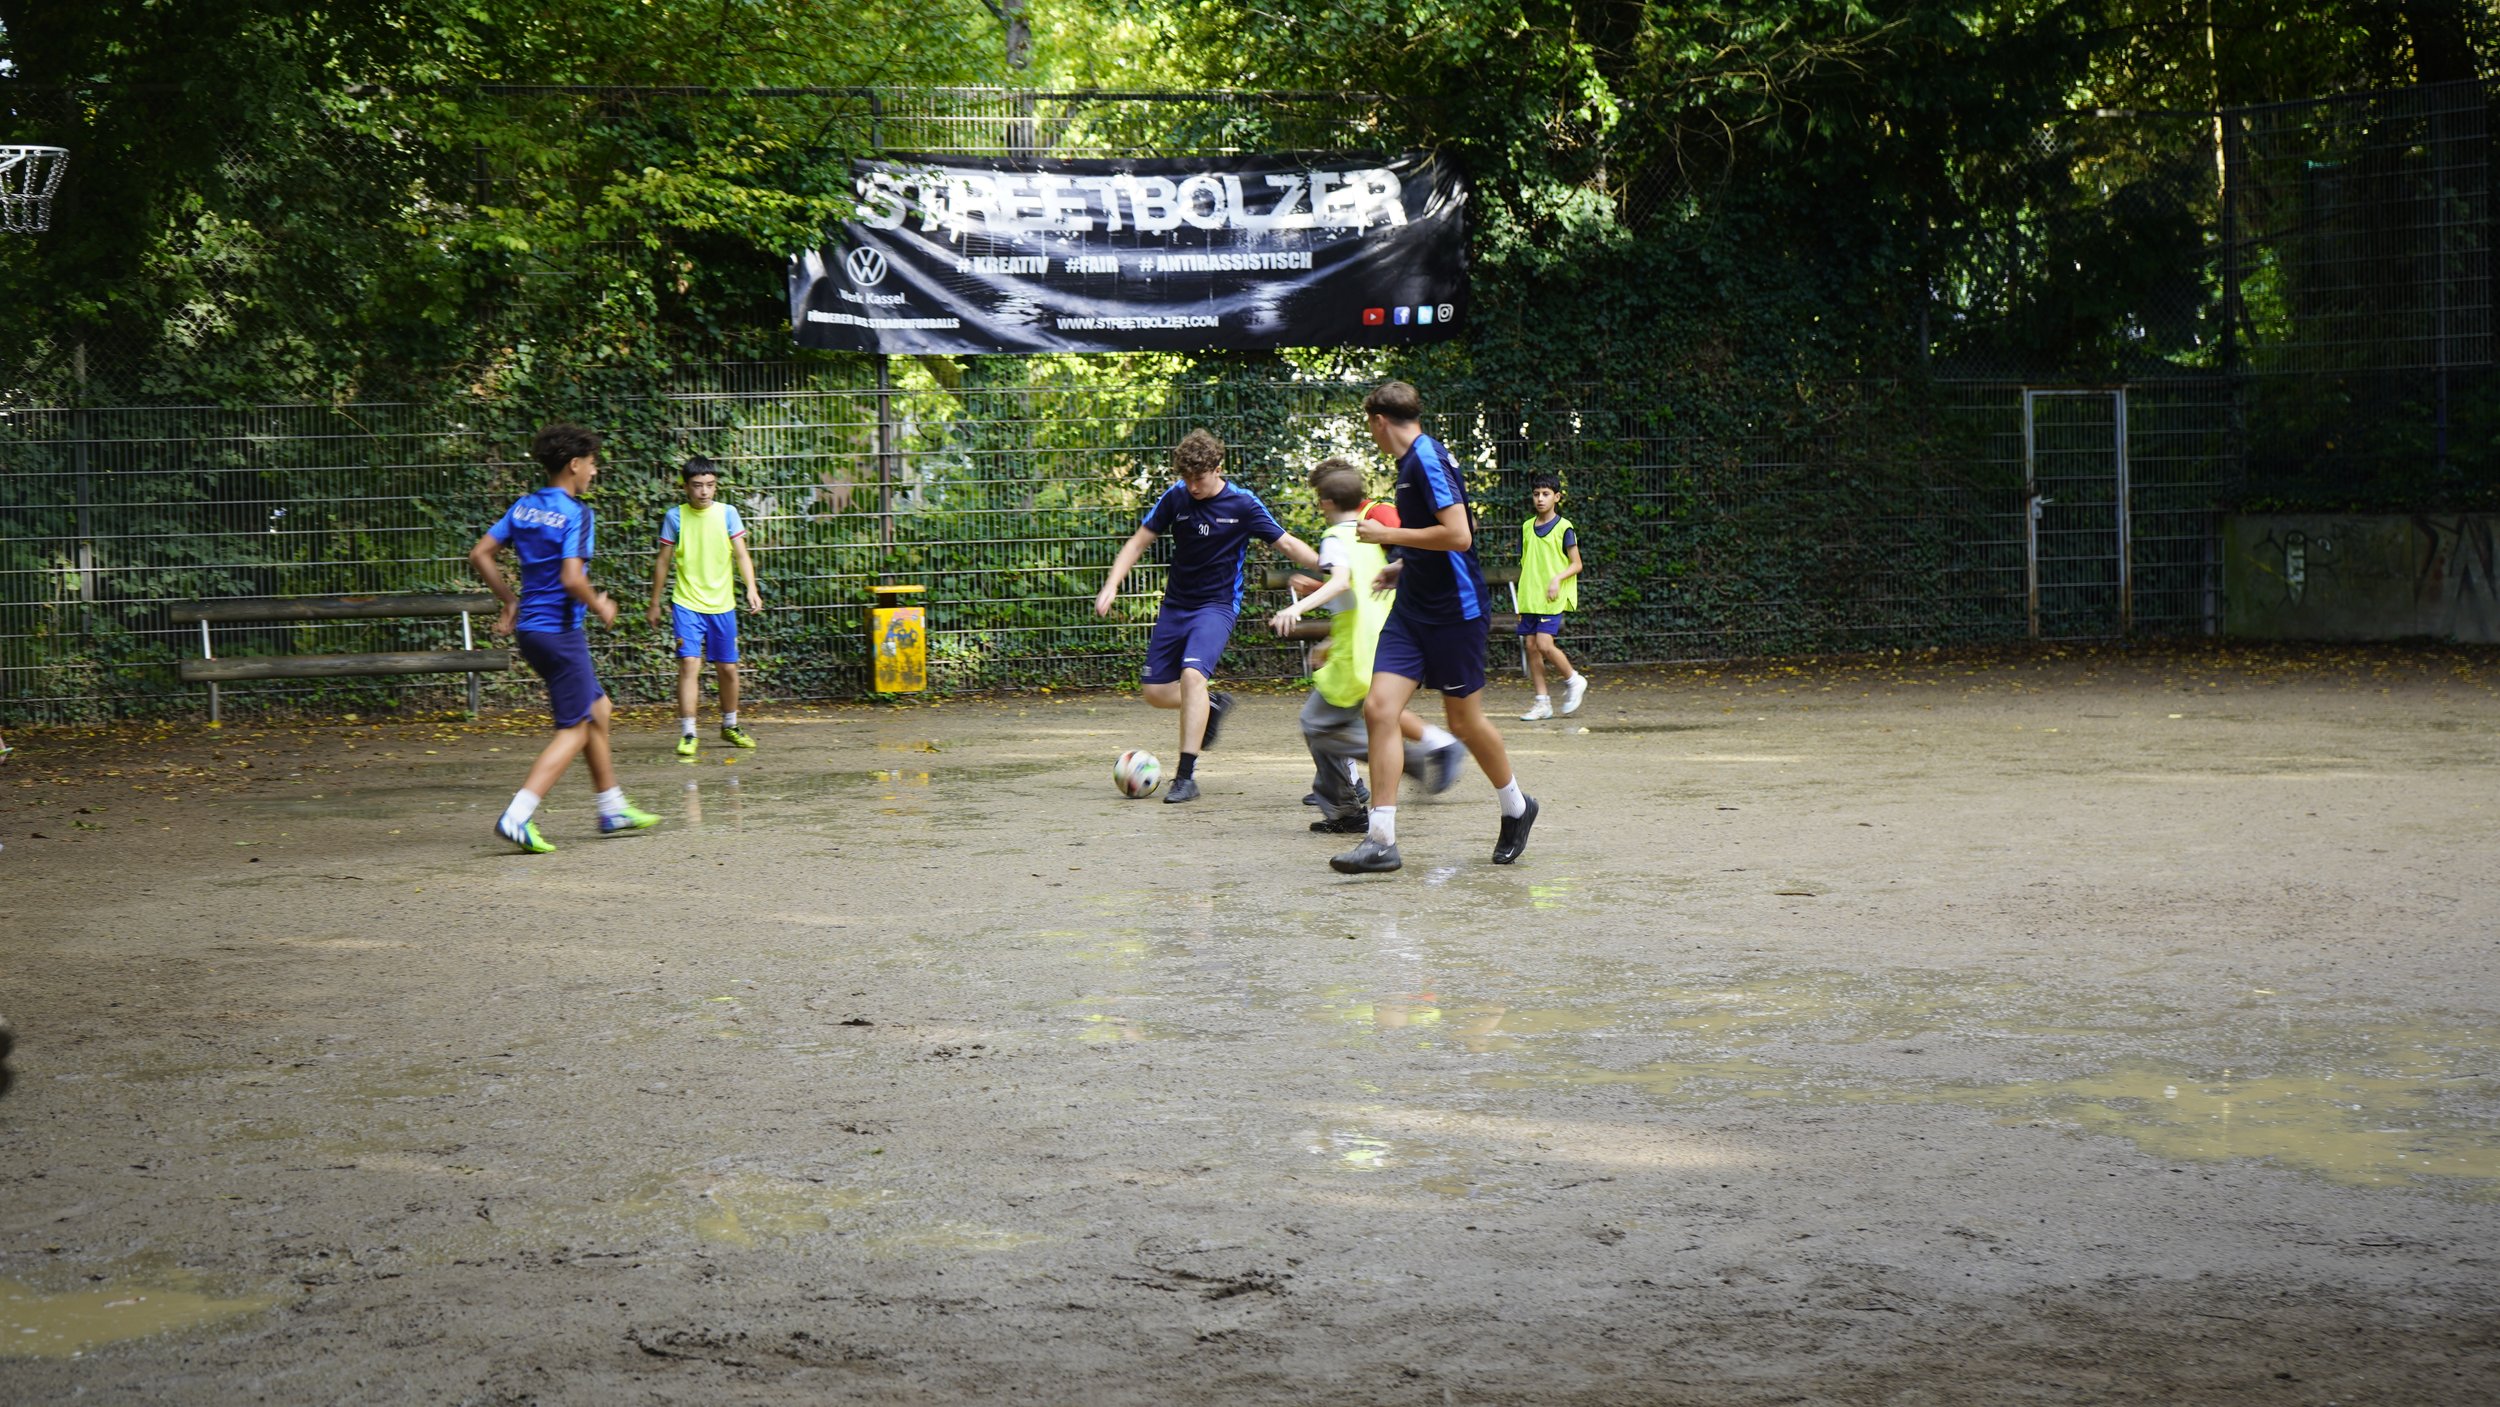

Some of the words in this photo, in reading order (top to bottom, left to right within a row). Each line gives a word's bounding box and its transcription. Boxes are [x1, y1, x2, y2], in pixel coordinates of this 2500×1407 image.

[856, 168, 1407, 243] STREETBOLZER
[865, 292, 906, 305] Kassel
[1056, 316, 1219, 330] WWW.STREETBOLZER.COM
